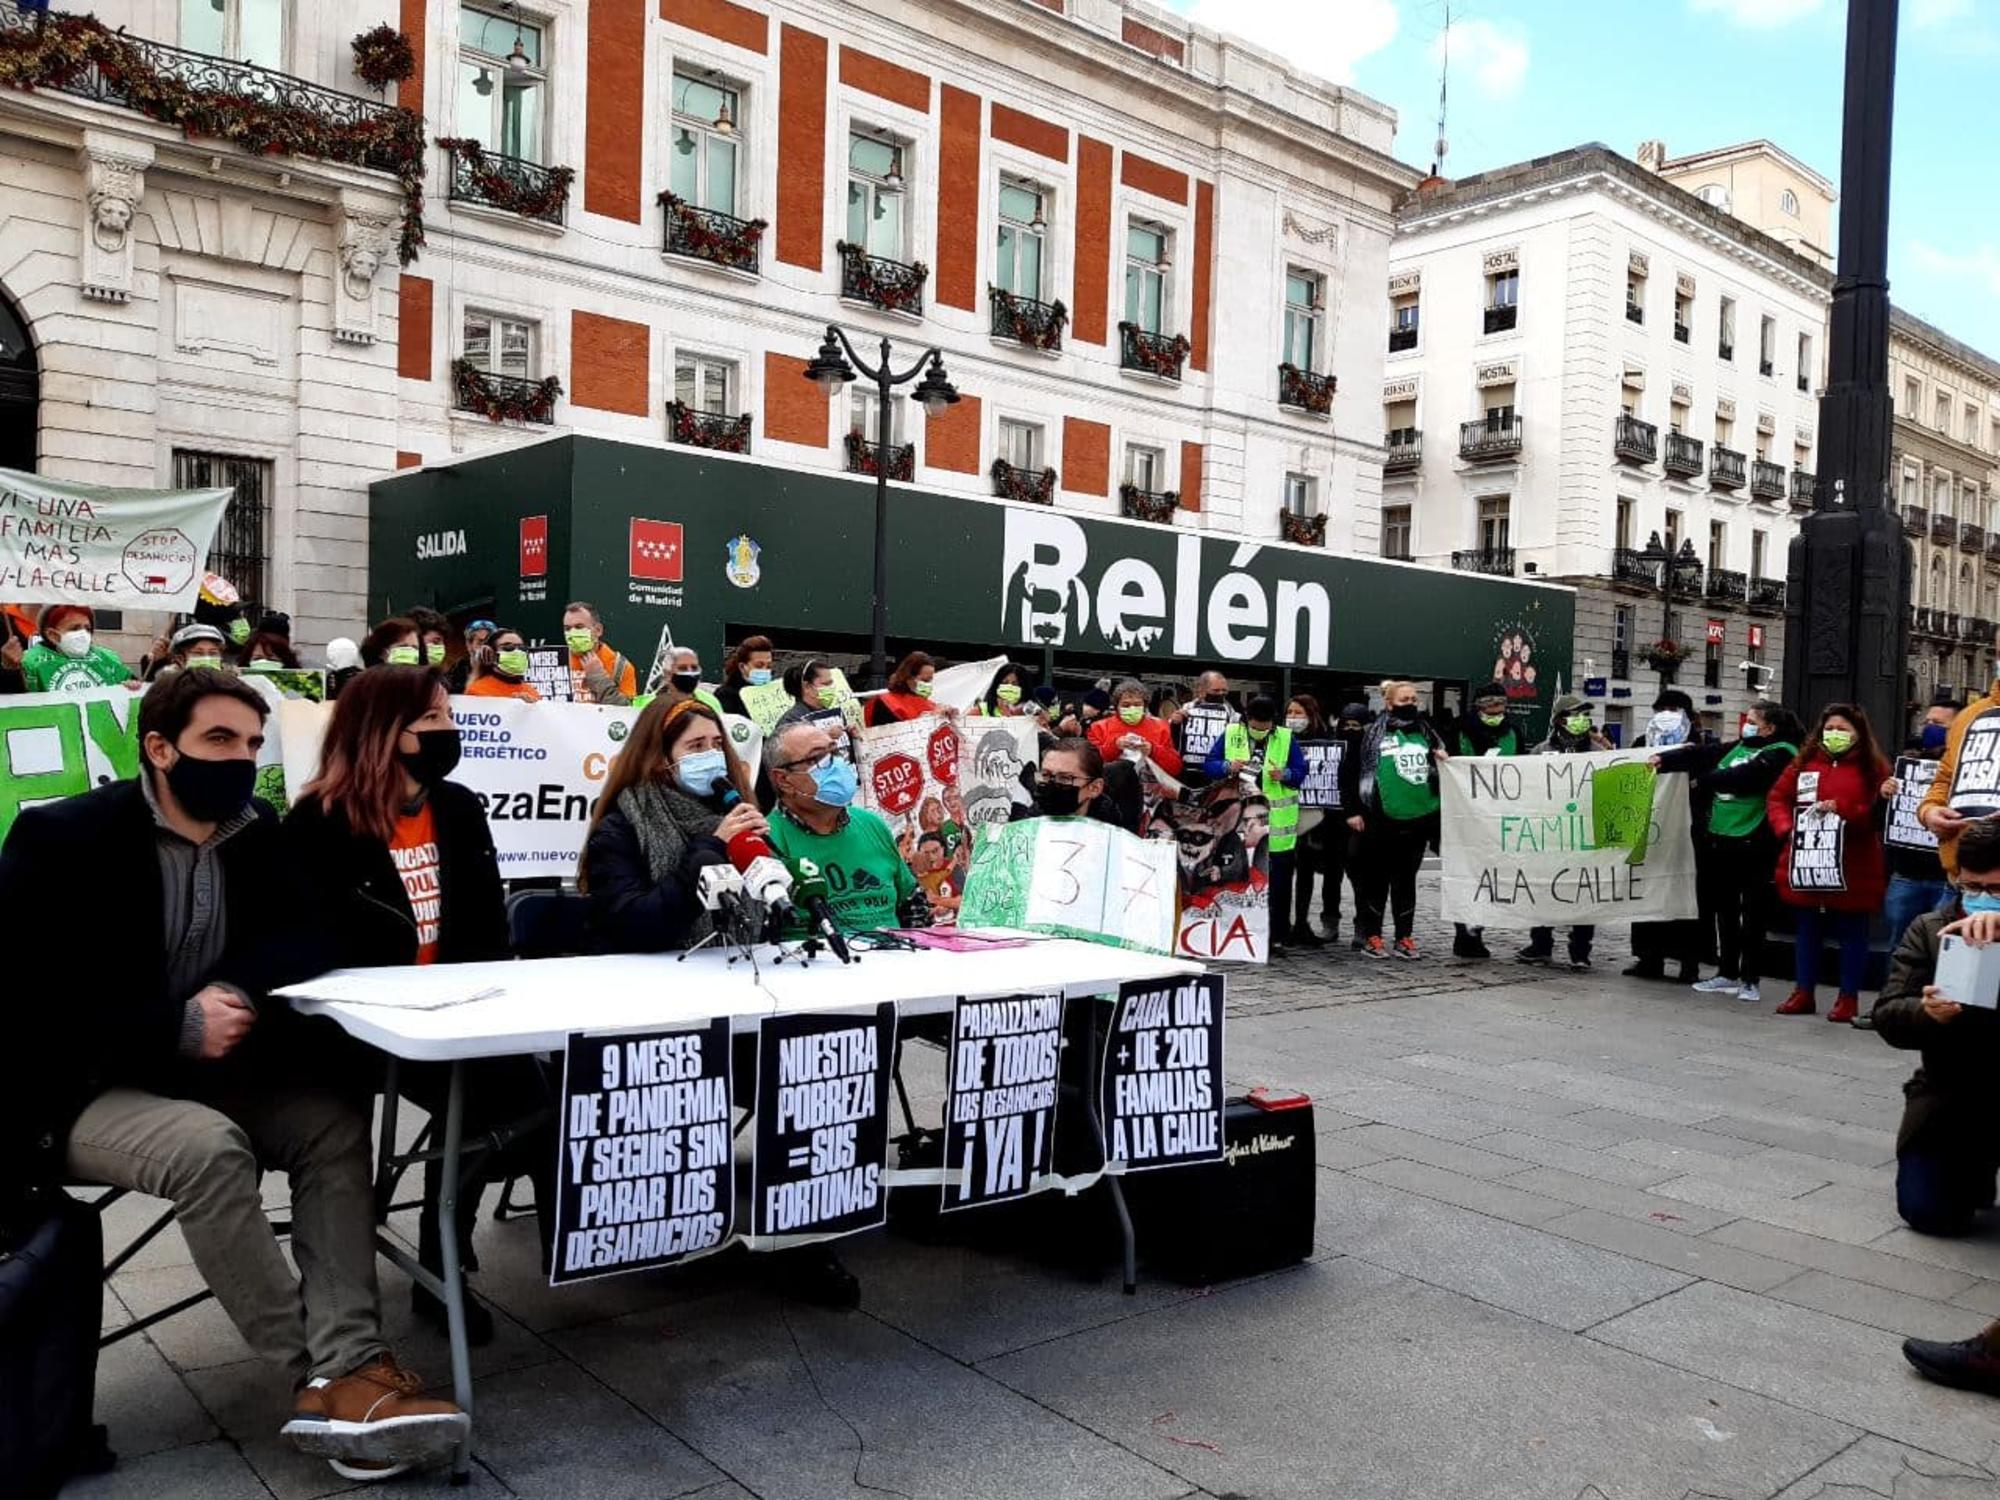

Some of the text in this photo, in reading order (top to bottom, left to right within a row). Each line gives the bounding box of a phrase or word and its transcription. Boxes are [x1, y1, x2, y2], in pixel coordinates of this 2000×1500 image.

[1484, 252, 1517, 268] HOSTAL
[1479, 365, 1513, 381] HOSTAL
[25, 542, 81, 564] MAS
[417, 529, 468, 560] SALIDA
[629, 582, 683, 595] Comunidad
[629, 593, 682, 608] de Madrid
[1001, 506, 1331, 668] Belén
[1708, 625, 1724, 638] KFC
[449, 713, 501, 727] UEVO
[876, 762, 912, 790] STOP
[1470, 762, 1522, 801] NO
[1551, 863, 1645, 905] CALLE
[959, 994, 1060, 1038] PARALIZACIÓN
[1120, 979, 1212, 1032] CADA DÍA
[602, 1034, 702, 1090] 9 MESES
[779, 1026, 879, 1087] NUESTRA
[956, 1030, 1058, 1092] DE TODOS
[1135, 1029, 1161, 1072] DE
[1165, 1027, 1209, 1069] 200
[569, 1076, 728, 1138] DE PANDEMIA
[777, 1072, 876, 1135] POBREZA
[954, 1079, 1056, 1123] LOS DESAHUCIOS
[1115, 1069, 1212, 1117] FAMILIAS
[569, 1122, 728, 1184] Y SEGUÍS SIN
[1113, 1111, 1218, 1161] A LA CALLE
[579, 1169, 717, 1229] PARAR LOS
[765, 1162, 879, 1234] FORTUNAS
[564, 1212, 724, 1273] DESAHUCIOS
